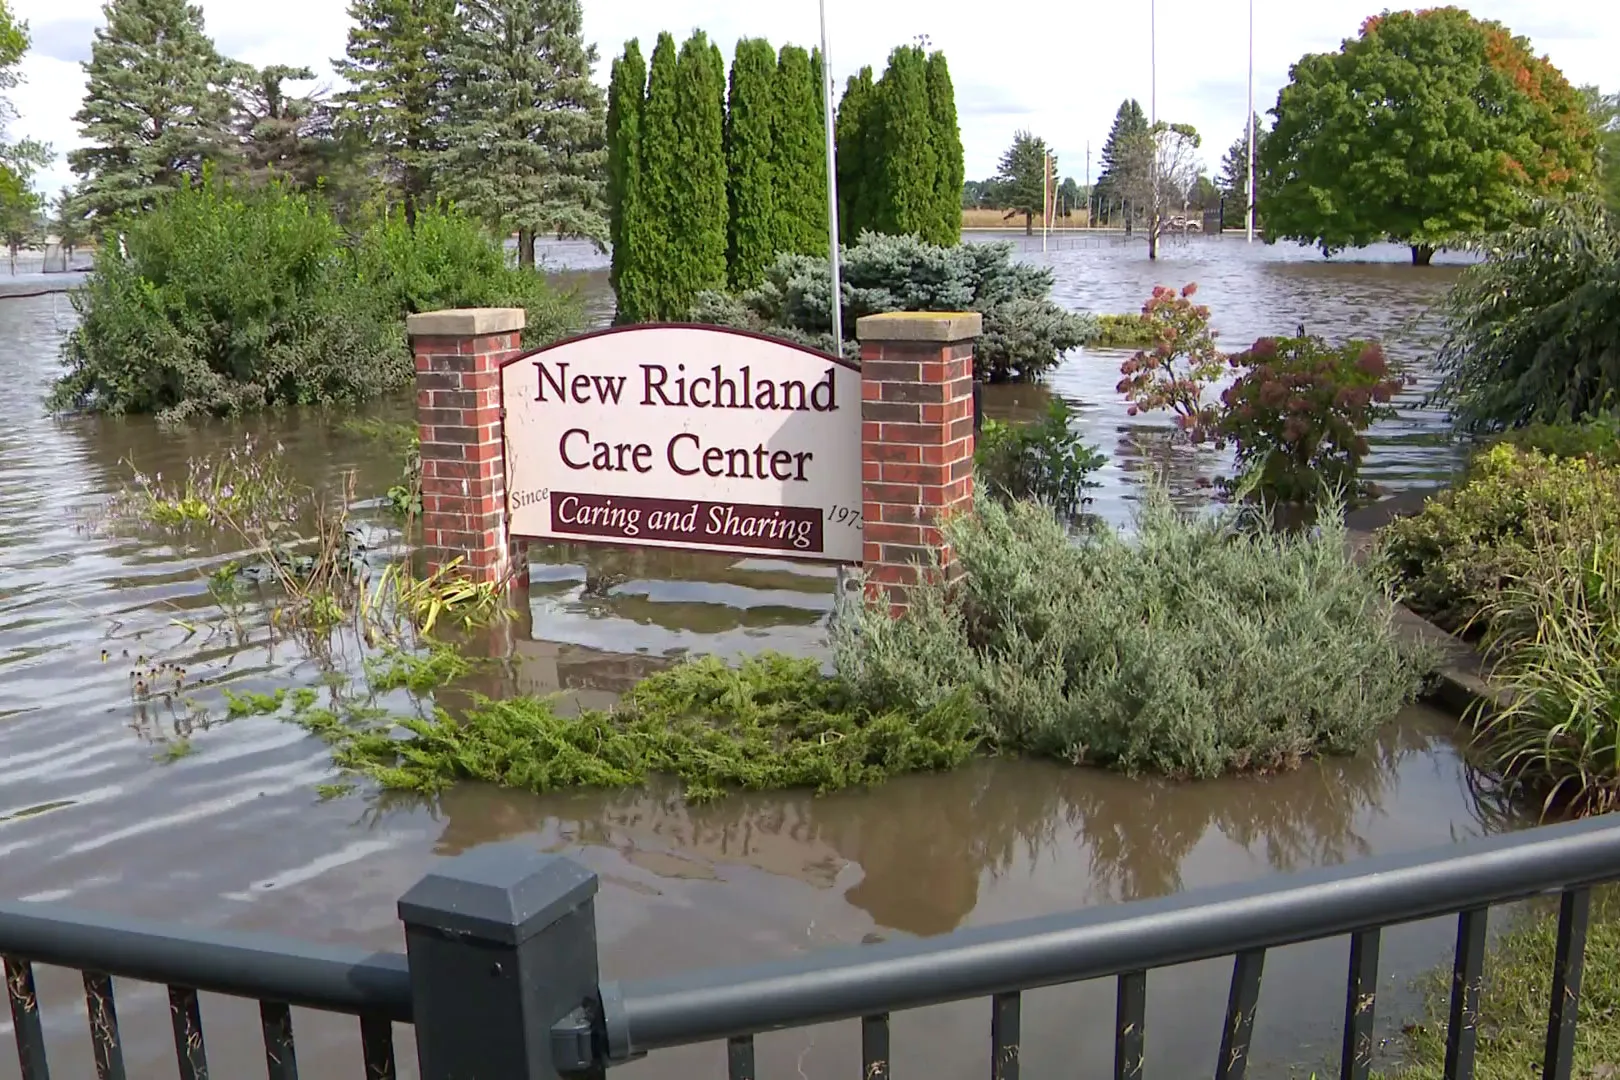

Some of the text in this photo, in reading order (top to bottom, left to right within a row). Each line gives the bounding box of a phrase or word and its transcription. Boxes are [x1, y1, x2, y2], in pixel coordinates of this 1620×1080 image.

[532, 361, 840, 411] New Richland
[559, 428, 814, 482] Care Center
[511, 487, 549, 510] Since
[558, 496, 813, 548] Caring and Sharing
